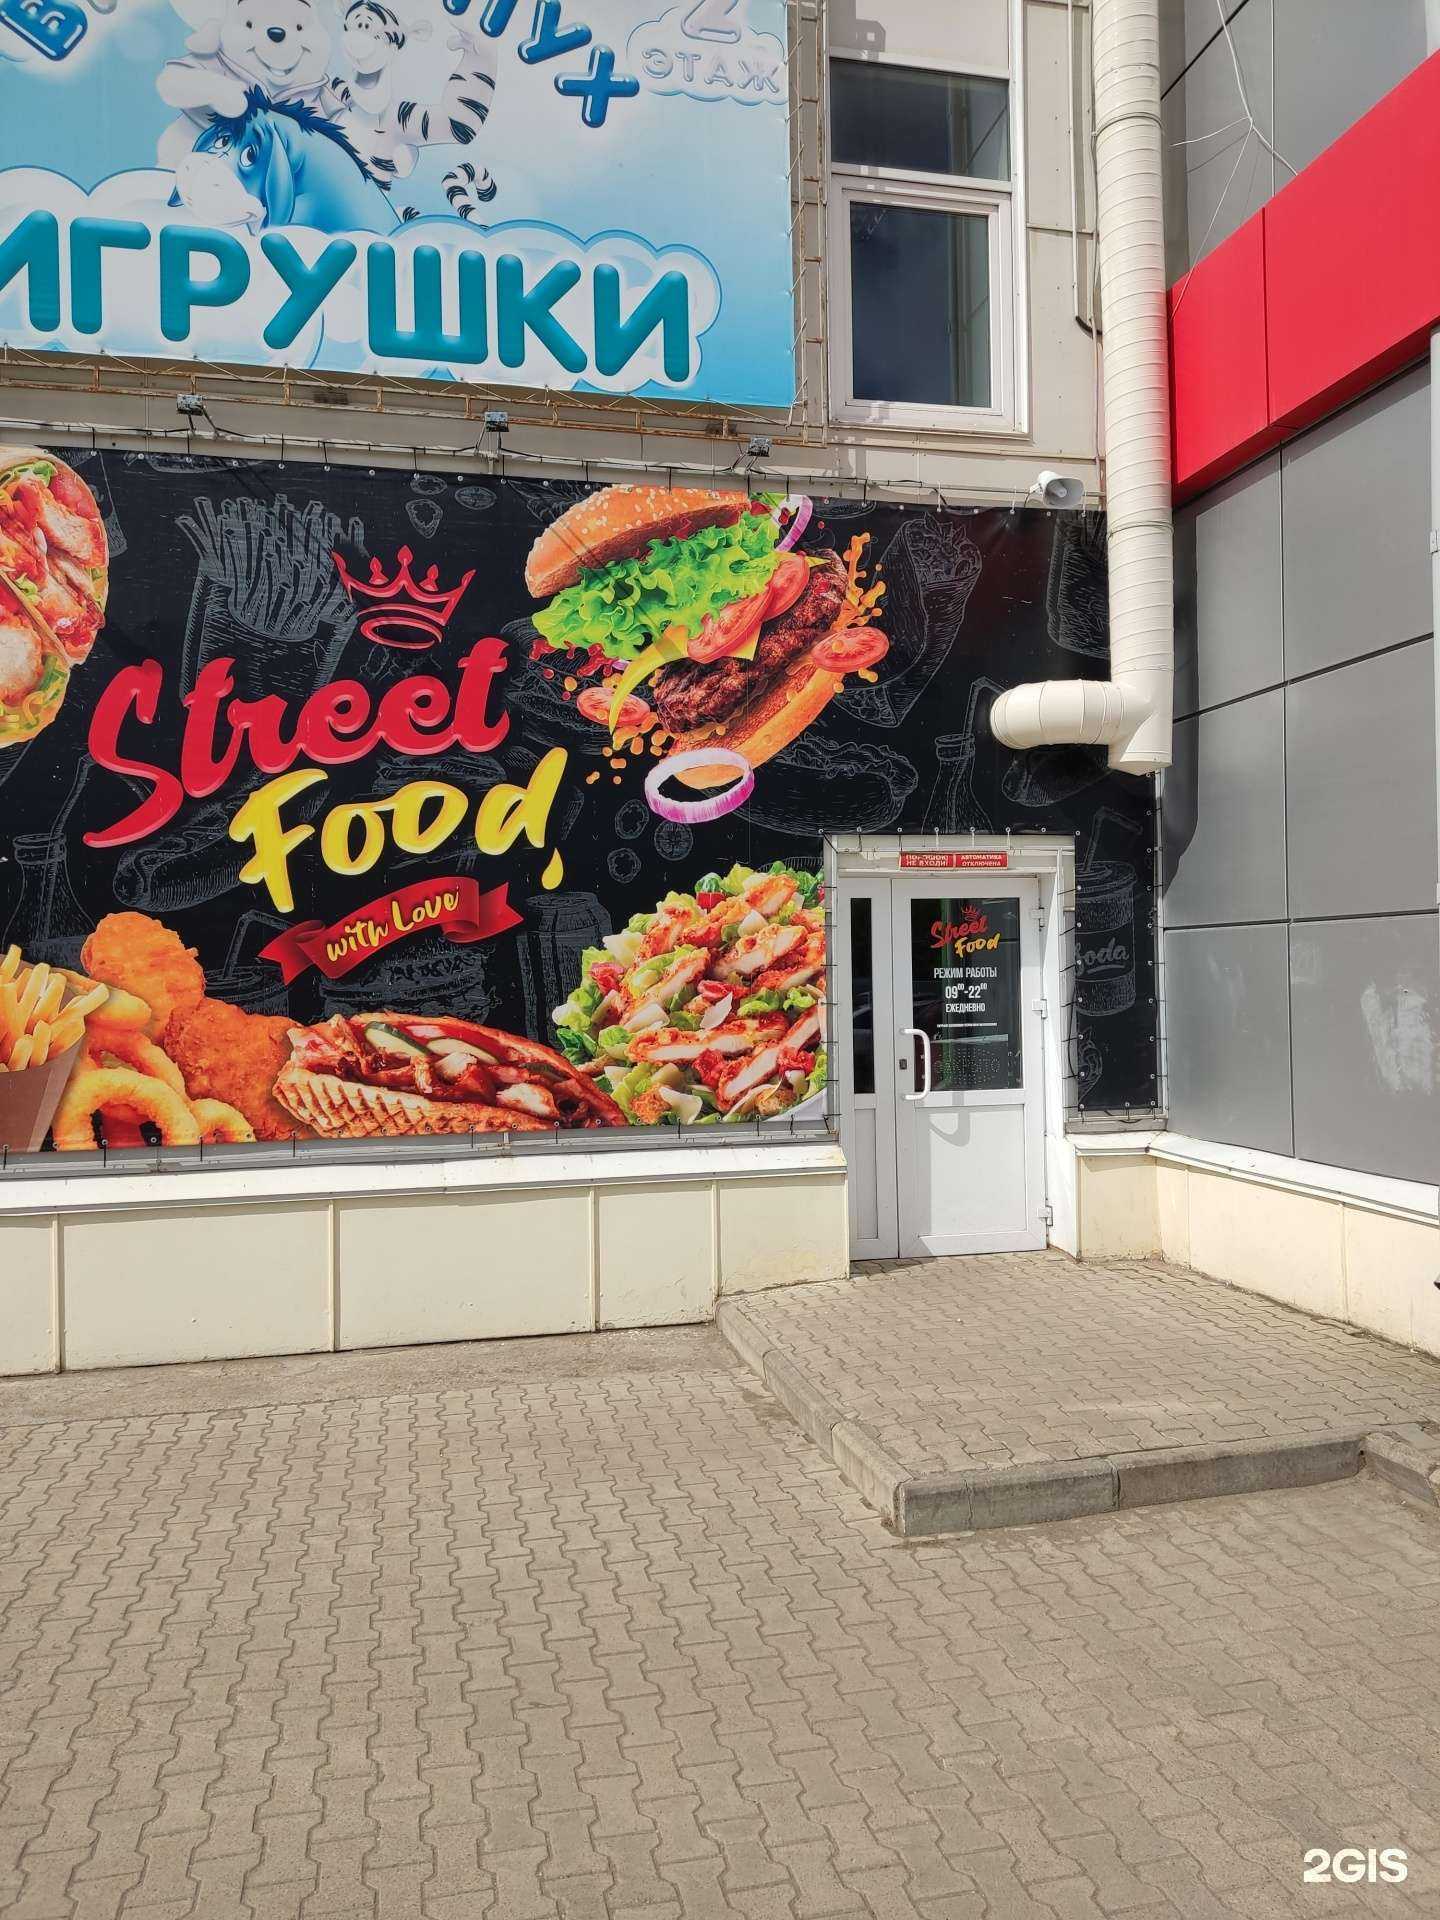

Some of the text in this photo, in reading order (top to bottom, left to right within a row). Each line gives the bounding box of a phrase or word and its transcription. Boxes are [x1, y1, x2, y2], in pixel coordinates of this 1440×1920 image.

[642, 48, 781, 94] ЭТАЖ
[0, 209, 692, 382] ИГРУШКИ
[83, 638, 510, 848] Street
[230, 747, 568, 913] Food
[325, 886, 459, 963] with Love
[930, 914, 988, 949] Street
[954, 932, 1001, 958] Food
[933, 966, 998, 979] РЕЖИМ РАБОТЫ
[945, 1002, 986, 1014] ЕЖЕДНЕВНО
